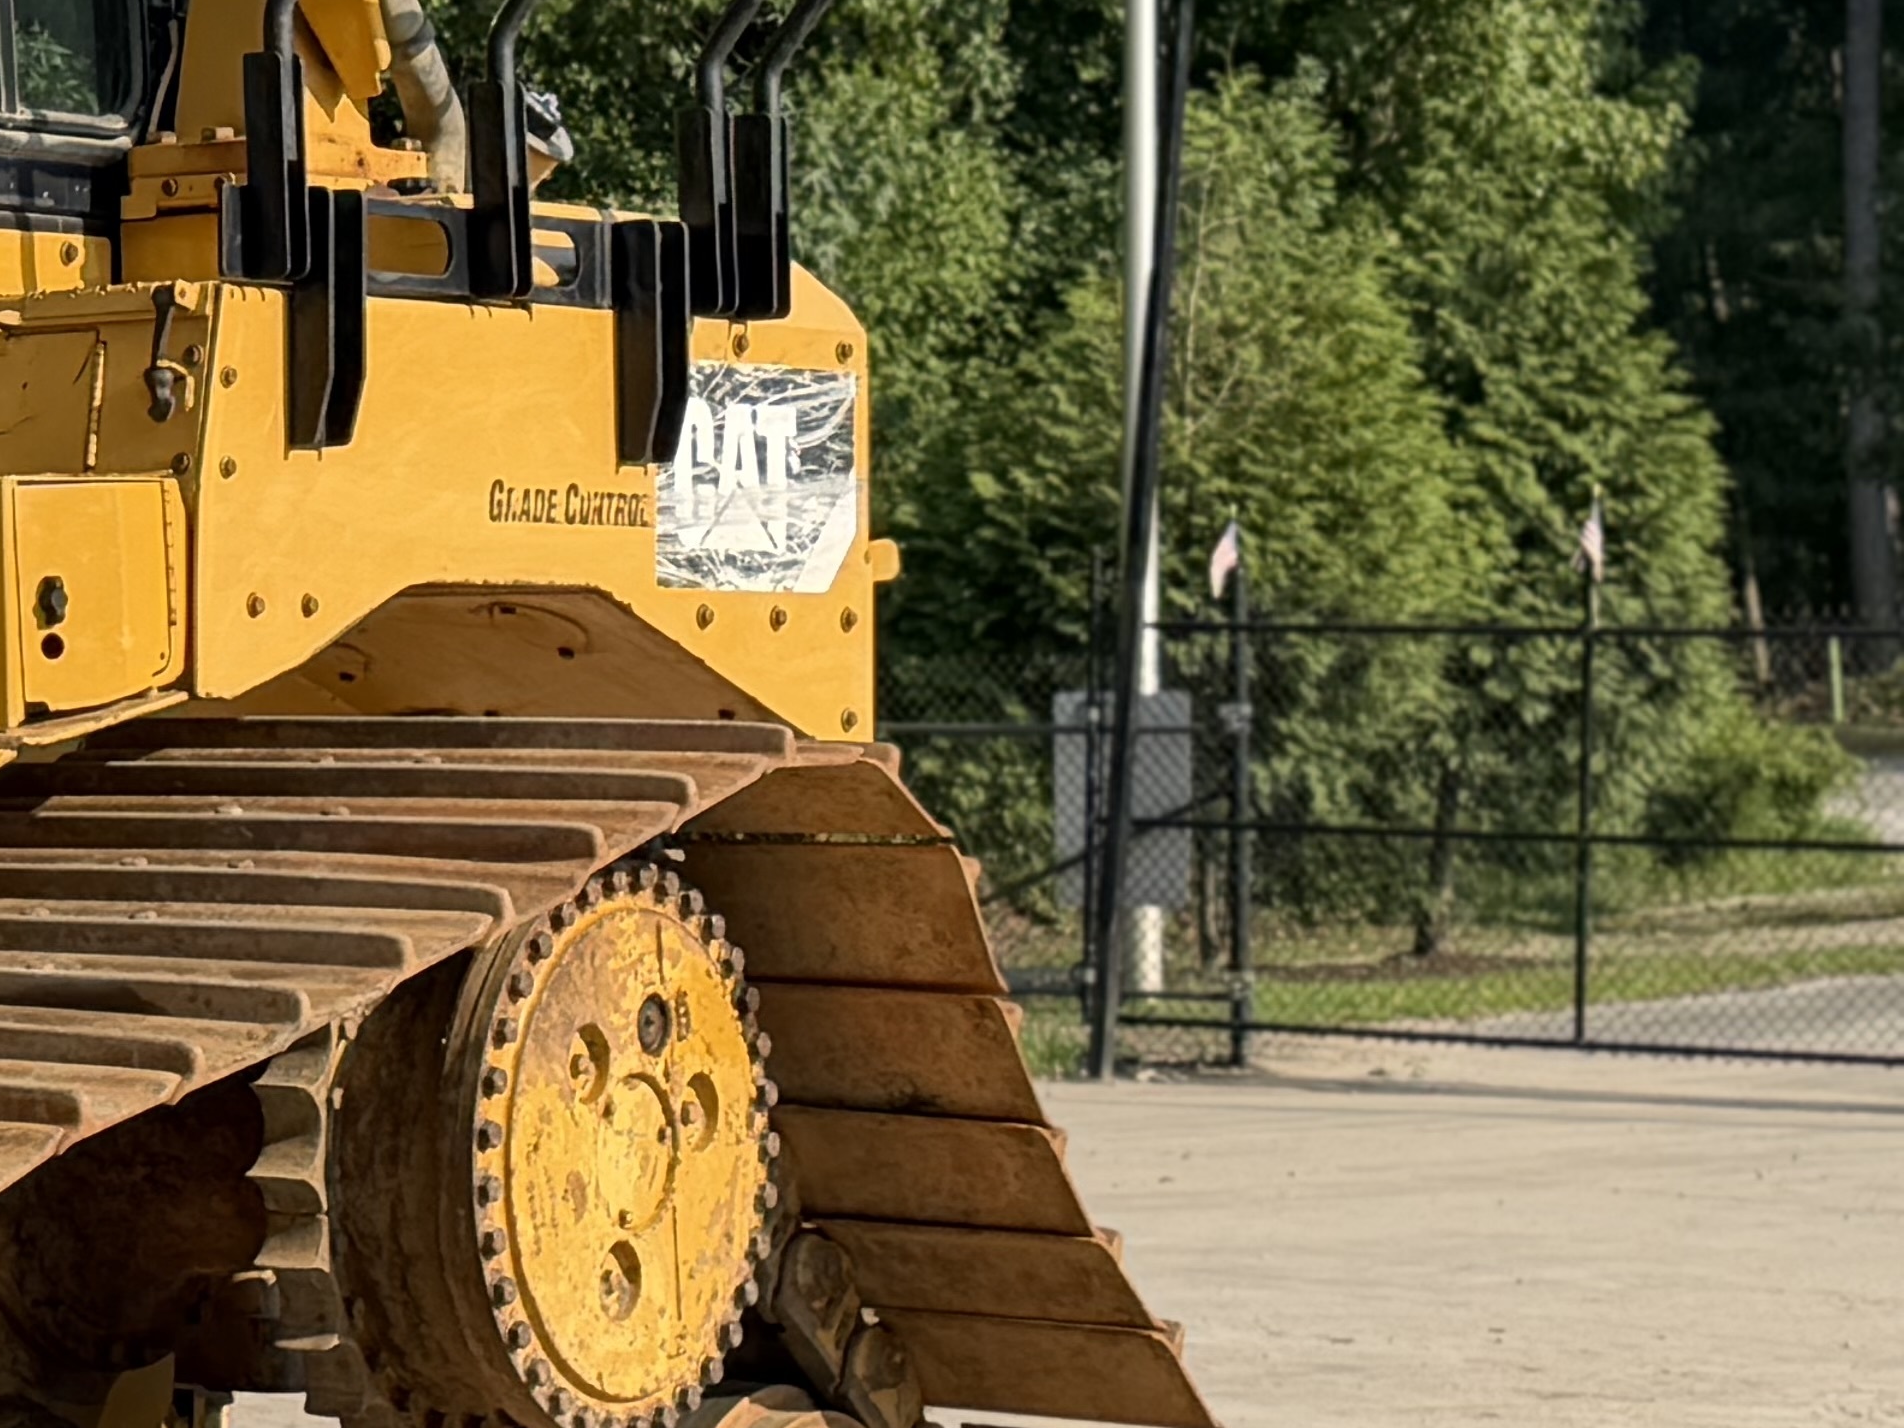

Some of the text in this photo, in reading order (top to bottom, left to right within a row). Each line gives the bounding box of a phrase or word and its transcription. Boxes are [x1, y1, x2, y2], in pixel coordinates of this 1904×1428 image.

[488, 478, 651, 528] GRADE CONTROL
[673, 396, 797, 550] CAT
